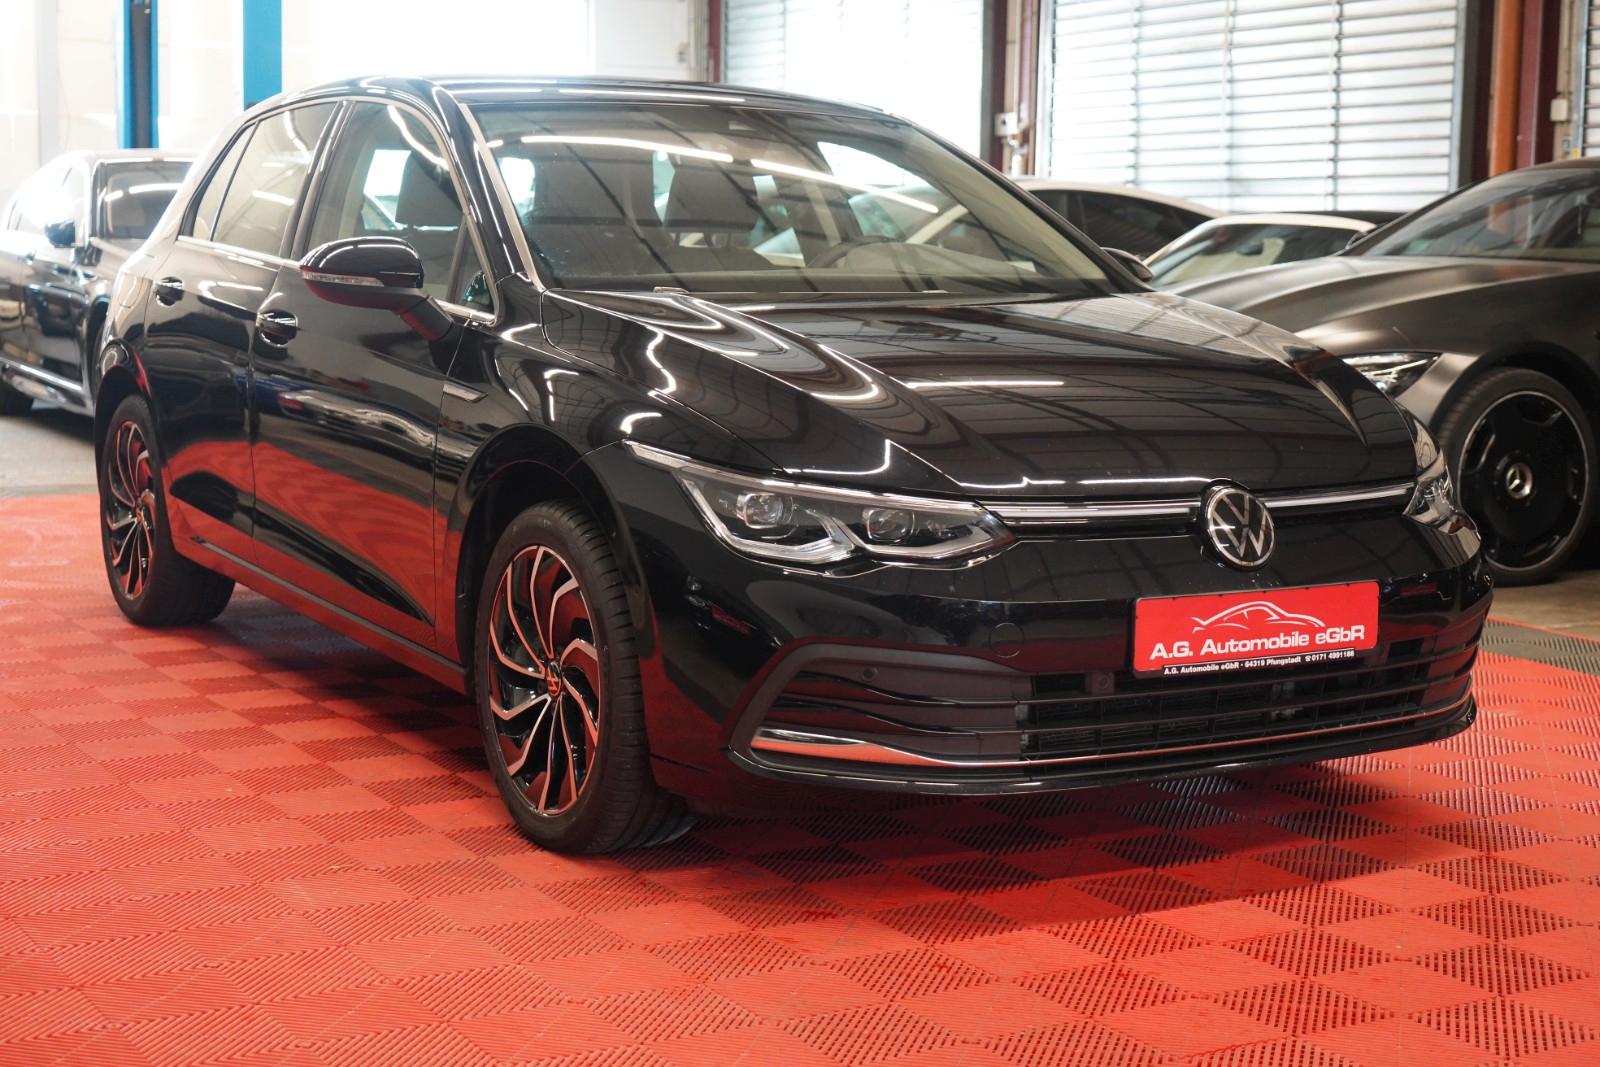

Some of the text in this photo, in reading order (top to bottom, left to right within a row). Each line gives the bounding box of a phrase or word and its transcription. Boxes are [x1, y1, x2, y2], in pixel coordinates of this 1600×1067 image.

[1150, 625, 1365, 660] A.G. Automobile eGbR
[1164, 667, 1179, 675] A.G.
[1180, 663, 1219, 674] Automobile
[1220, 661, 1240, 670] eGbR
[1244, 660, 1266, 668] 64319
[1266, 656, 1302, 667] Pfungstadt
